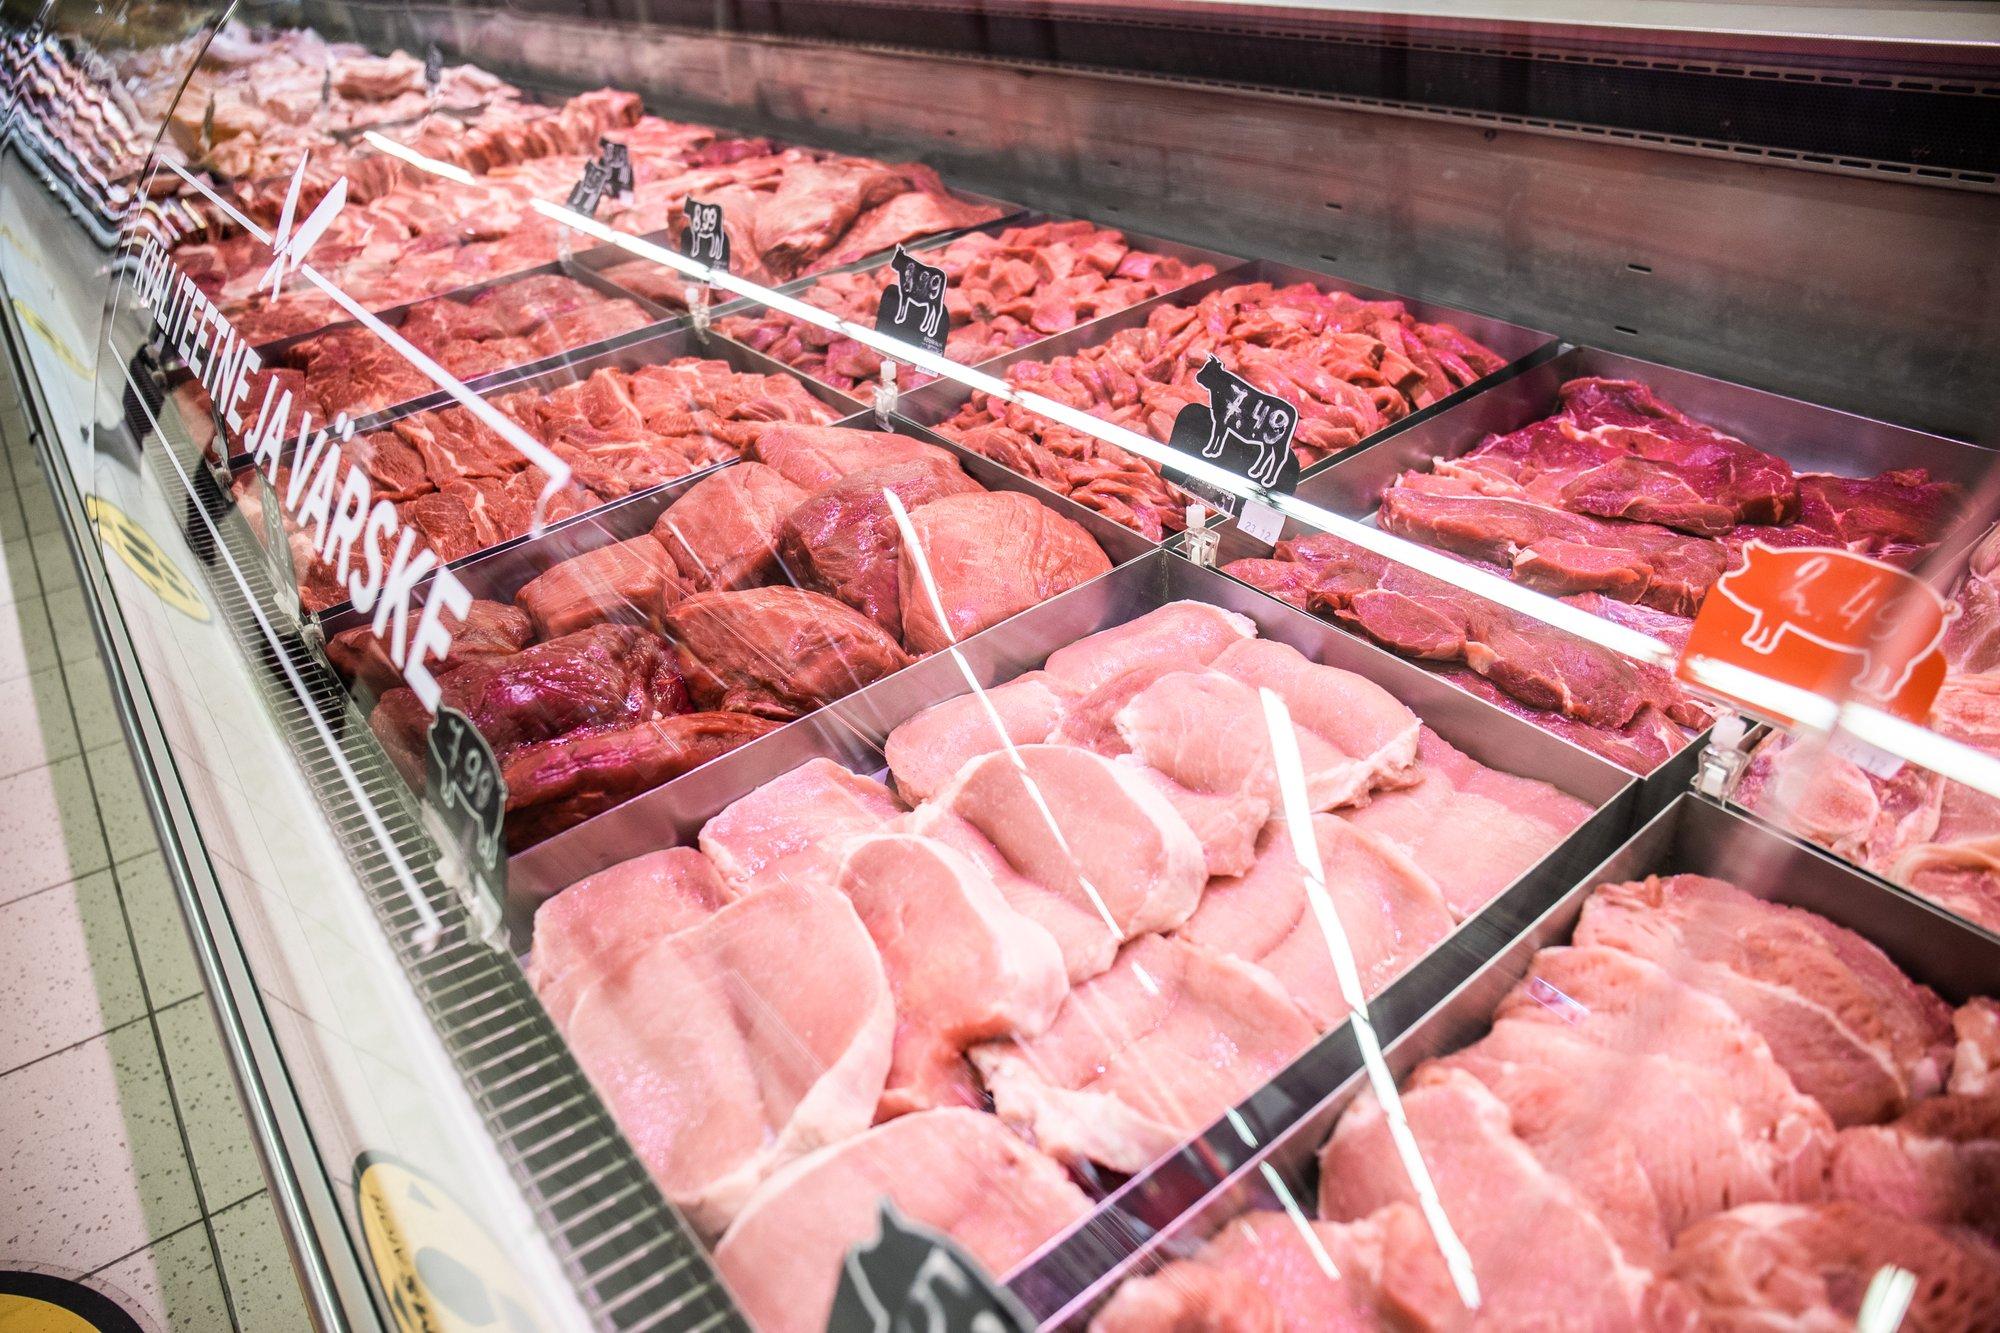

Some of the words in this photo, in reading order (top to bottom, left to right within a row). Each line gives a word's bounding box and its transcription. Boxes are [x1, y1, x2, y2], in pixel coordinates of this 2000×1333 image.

[133, 233, 263, 435] KVALITEETNE
[244, 374, 293, 486] JA
[286, 410, 474, 714] VÄRSKE
[1224, 384, 1290, 444] 7.49
